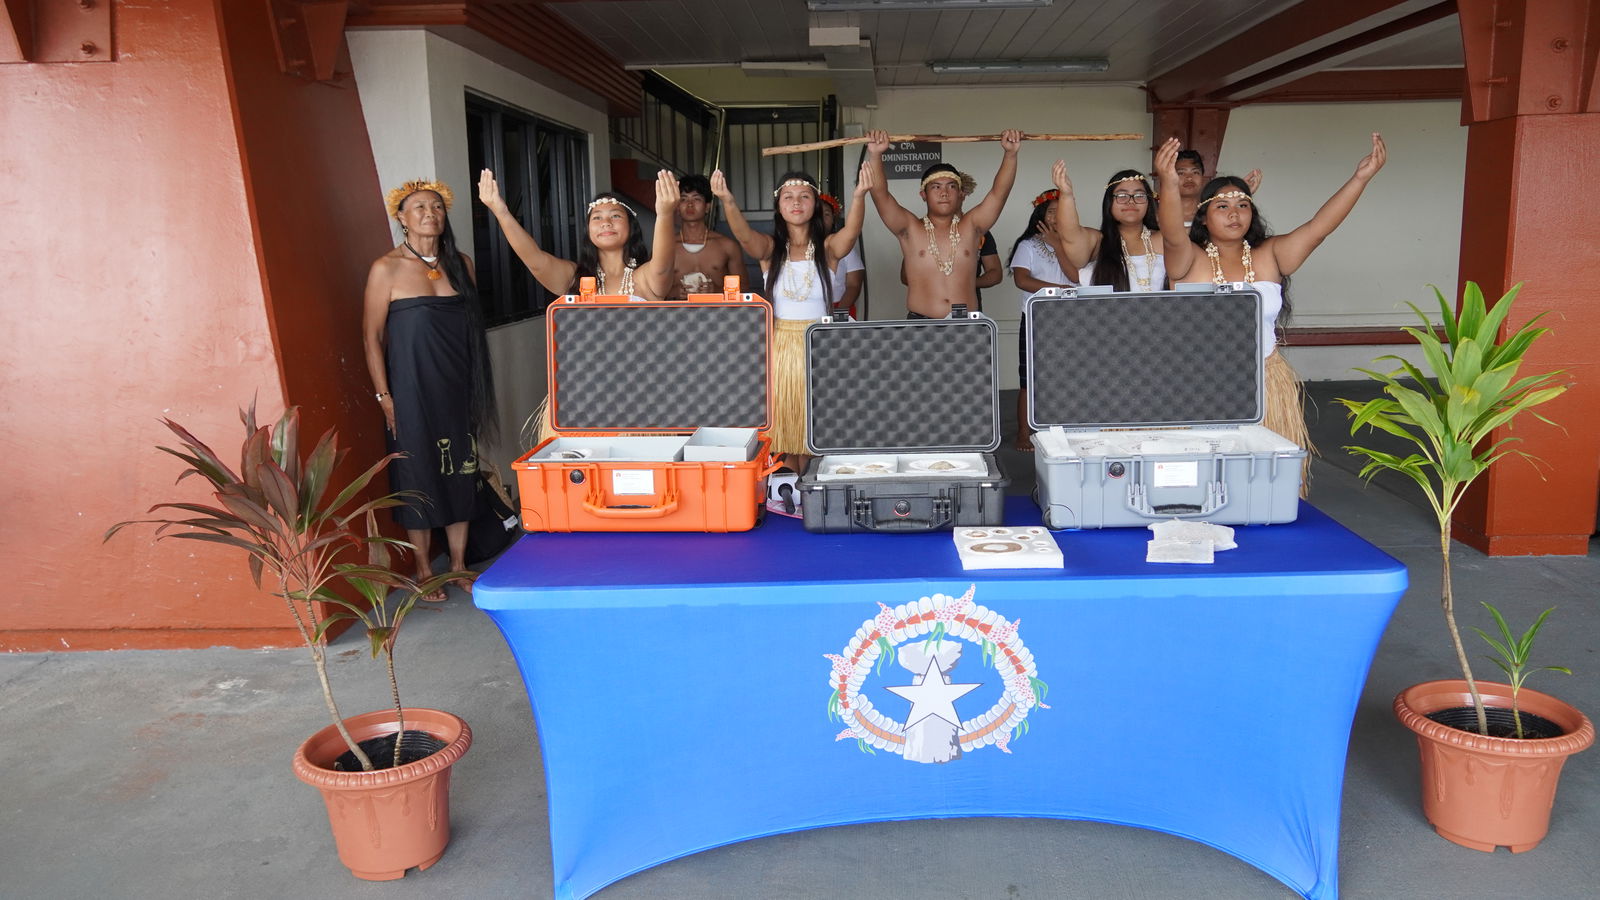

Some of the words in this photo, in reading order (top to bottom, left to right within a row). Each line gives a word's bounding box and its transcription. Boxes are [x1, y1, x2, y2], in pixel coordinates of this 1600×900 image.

[900, 142, 916, 150] CPA
[881, 152, 941, 162] DMINISTRATION
[894, 164, 922, 172] OFFICE
